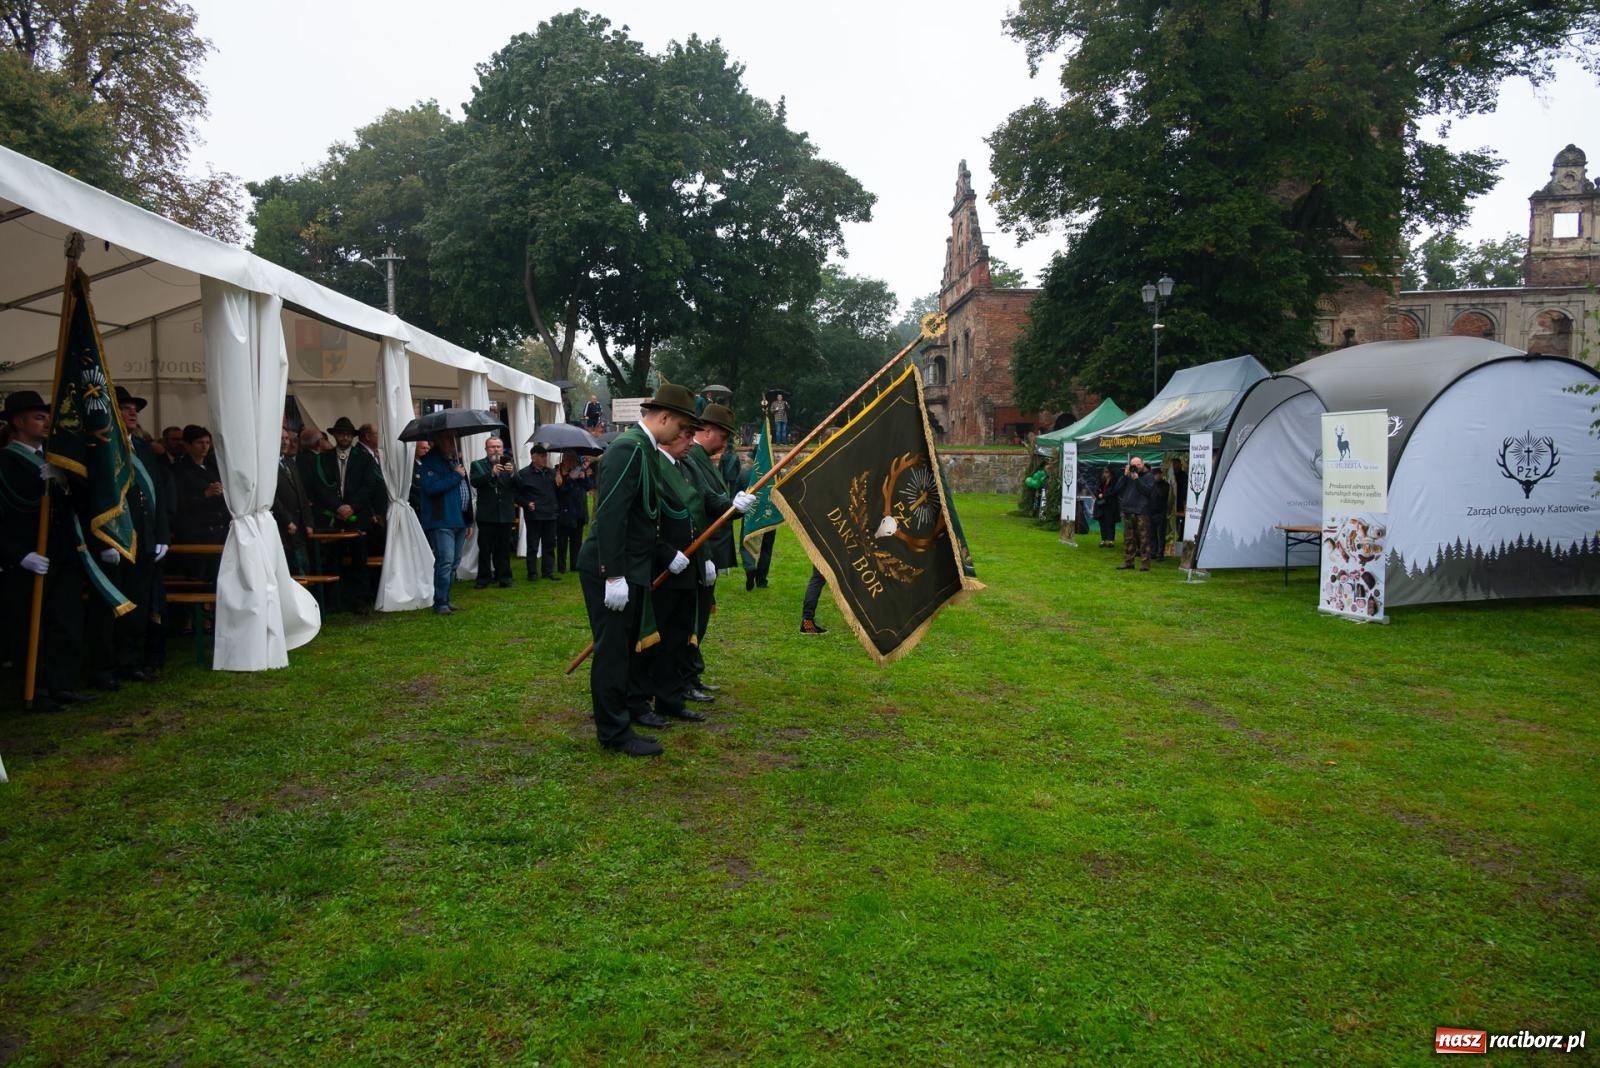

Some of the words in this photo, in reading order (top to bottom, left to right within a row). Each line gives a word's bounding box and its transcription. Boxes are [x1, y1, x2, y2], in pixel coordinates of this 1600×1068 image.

[1517, 465, 1540, 479] PZŁ
[1466, 506, 1497, 517] Zarząd
[1499, 505, 1546, 517] Okręgowy
[1548, 504, 1590, 513] Katowice
[827, 507, 858, 553] DARZ
